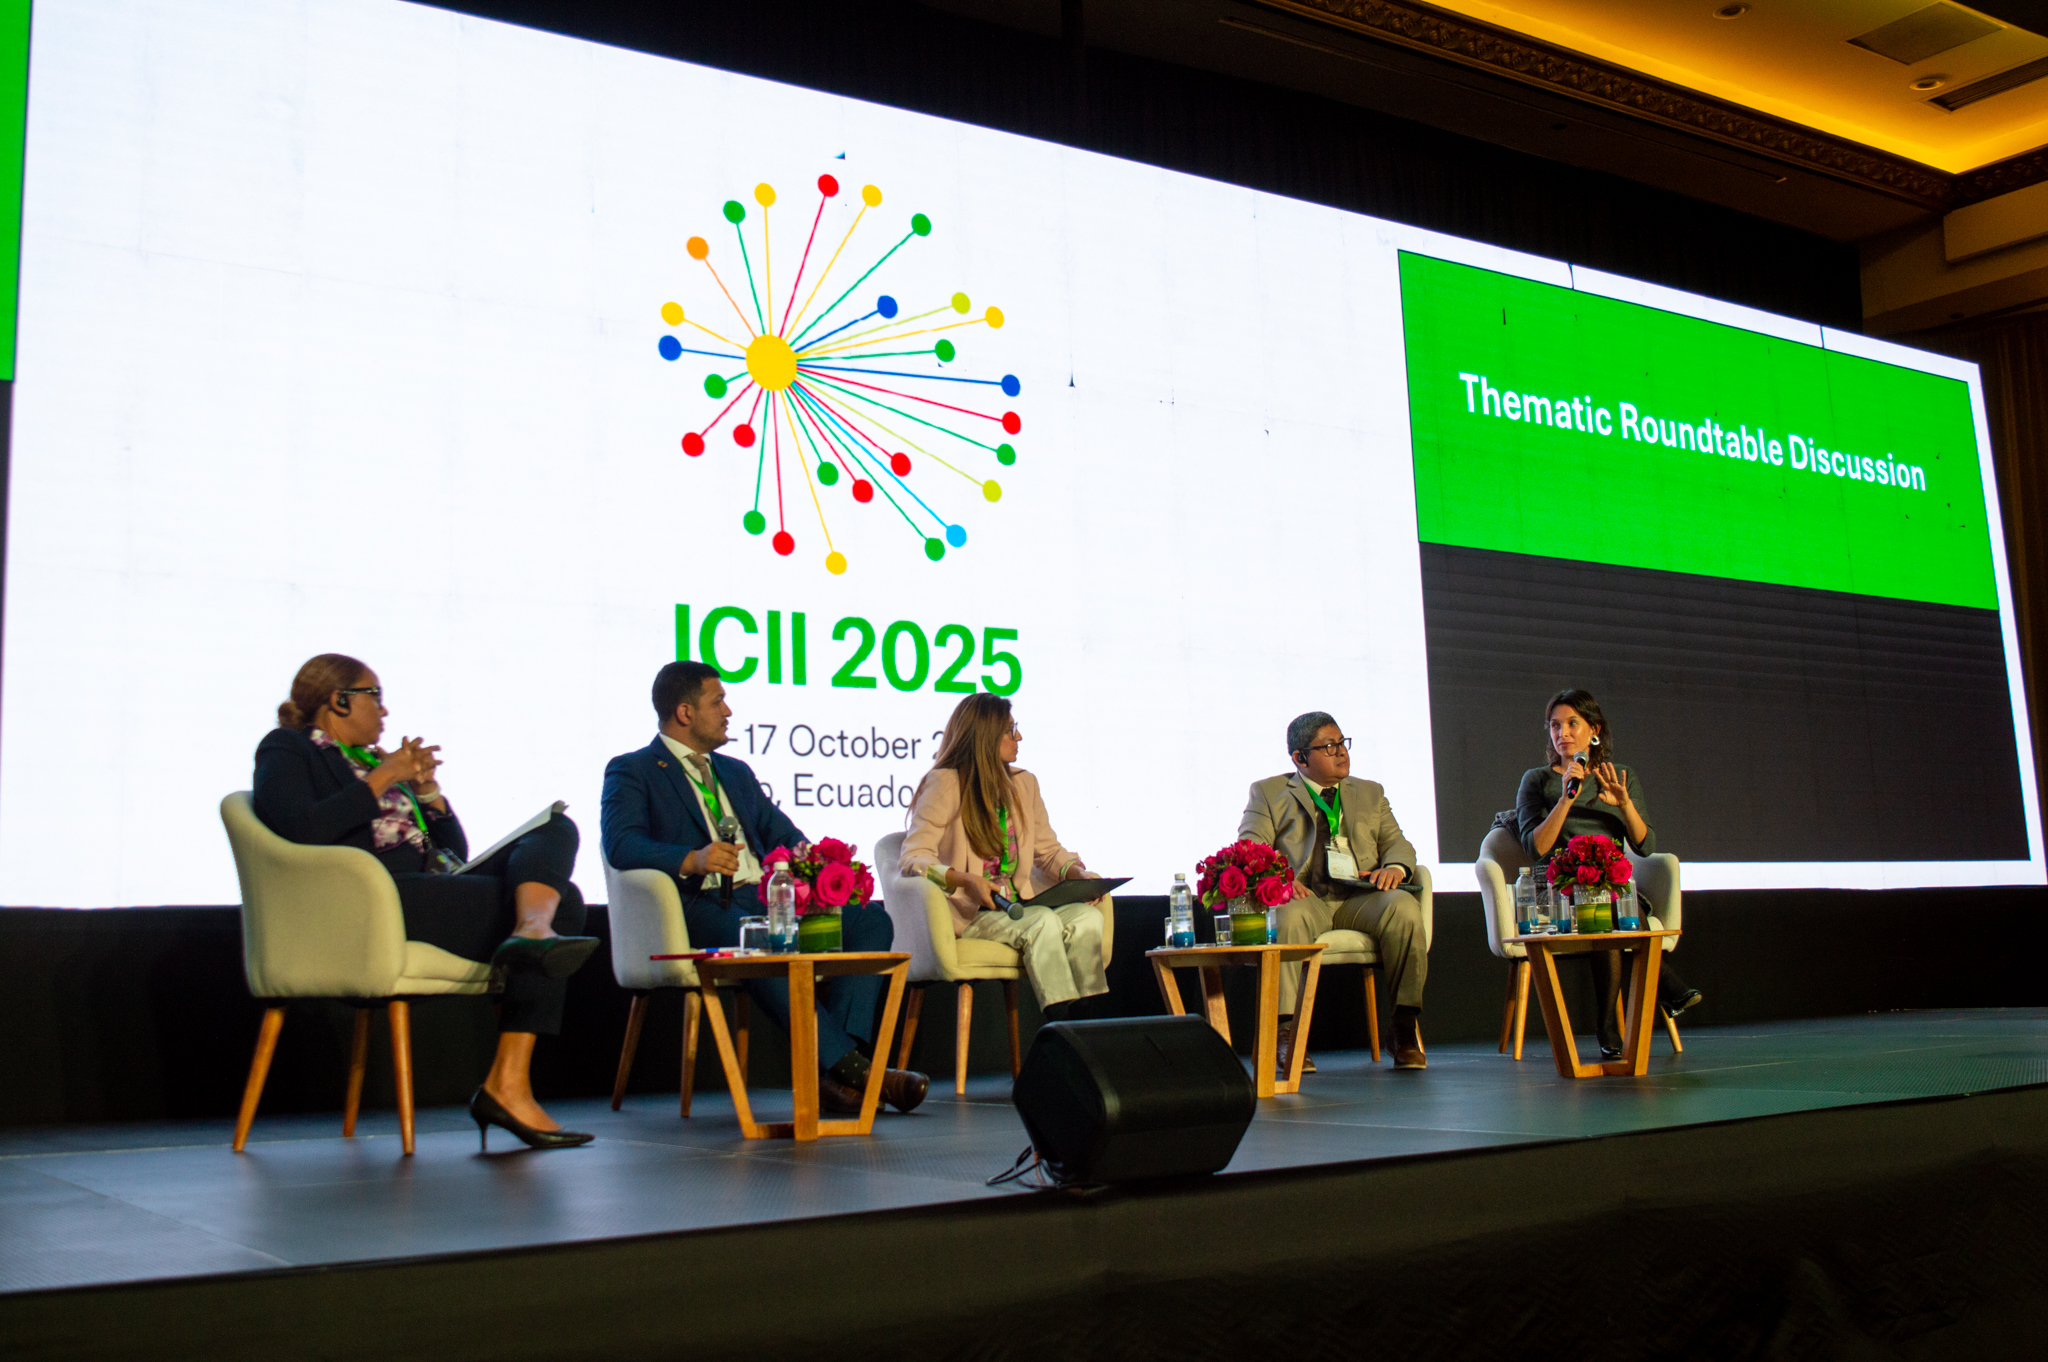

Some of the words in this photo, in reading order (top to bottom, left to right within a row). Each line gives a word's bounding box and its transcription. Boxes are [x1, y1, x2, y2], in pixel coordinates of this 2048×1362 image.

[1459, 372, 1612, 435] Thematic
[1619, 402, 1784, 466] Roundtable
[1788, 434, 1926, 491] Discussion
[675, 603, 806, 685] ICII
[831, 616, 1022, 697] 2025
[789, 724, 922, 759] October
[794, 773, 915, 808] Ecuado
